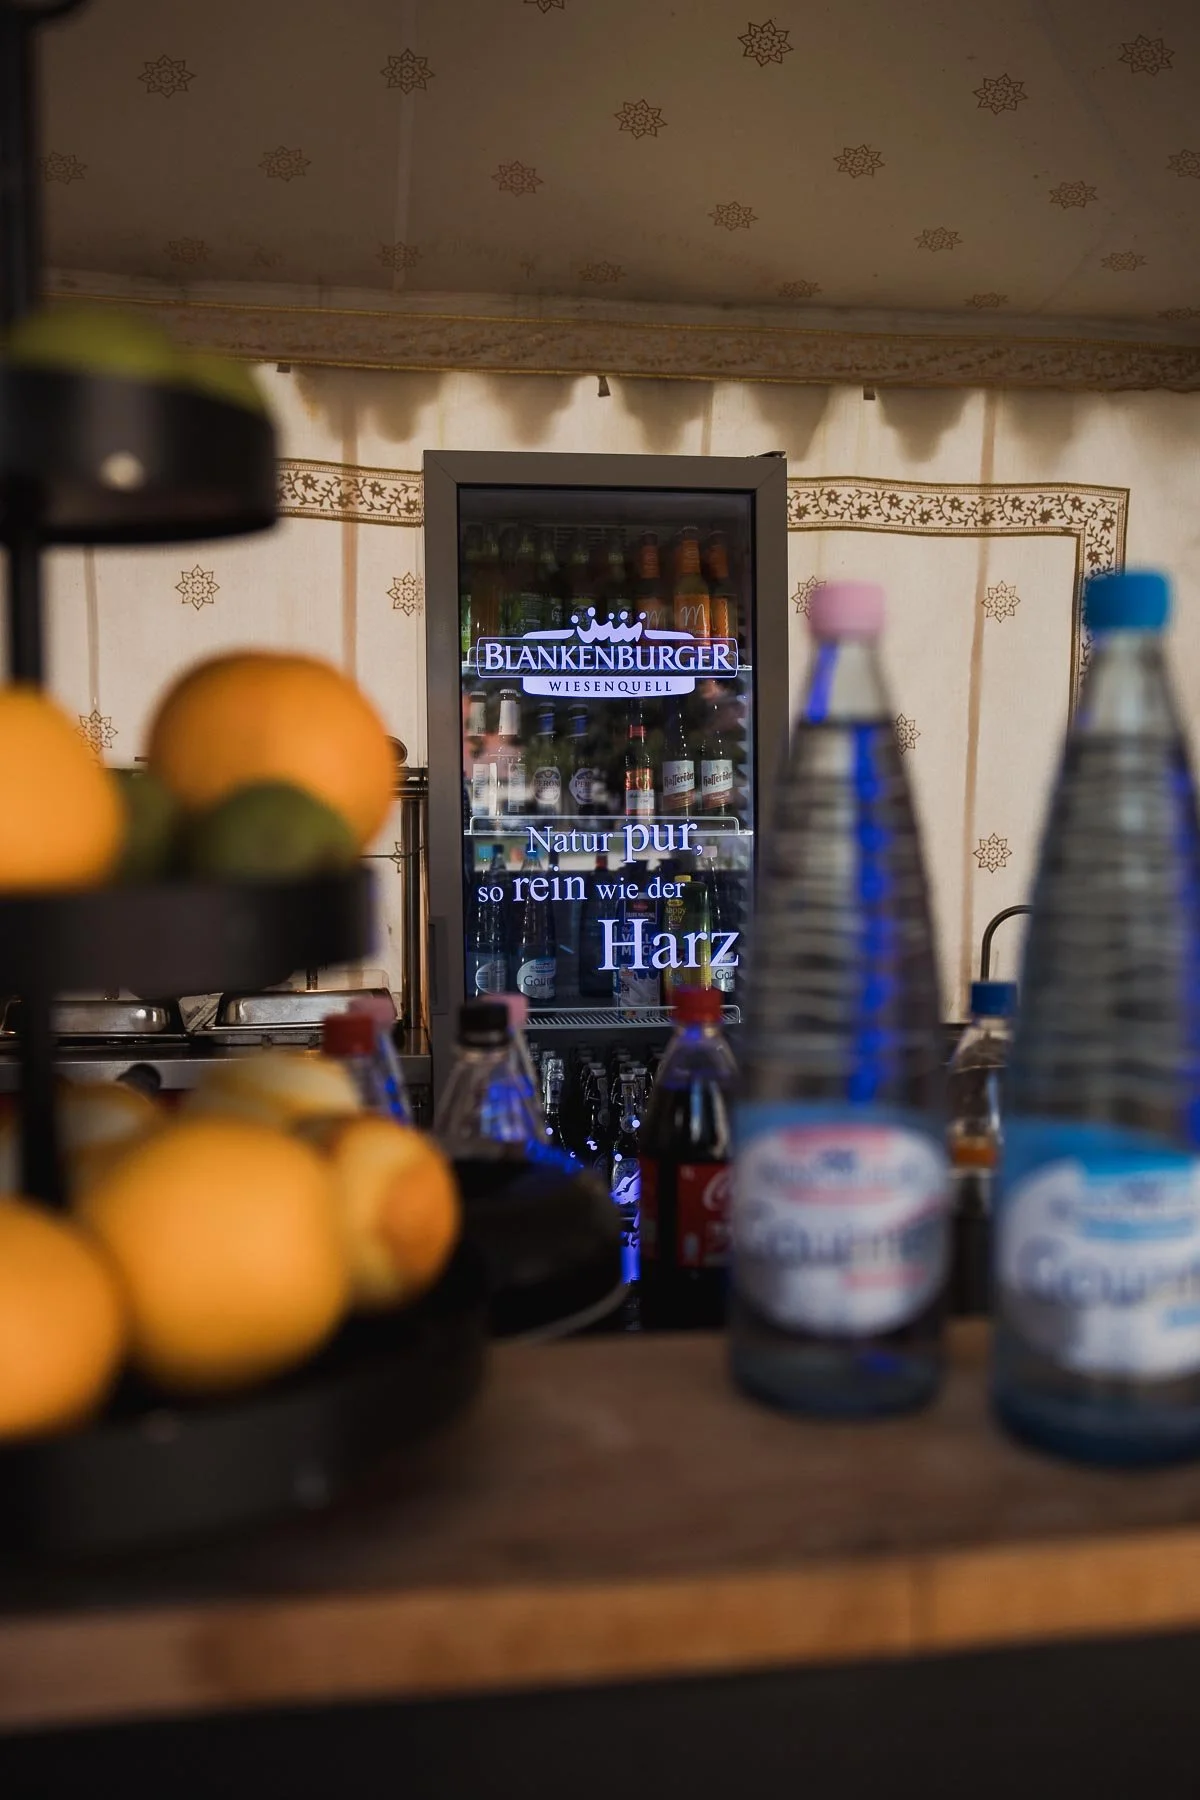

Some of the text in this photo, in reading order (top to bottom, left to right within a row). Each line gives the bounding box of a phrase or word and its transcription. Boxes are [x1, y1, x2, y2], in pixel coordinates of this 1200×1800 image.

[484, 642, 734, 671] BLANKENBURGER
[549, 680, 672, 695] WIESENQUELL
[526, 823, 703, 864] Natur pur,
[478, 865, 686, 903] so rein wie der
[597, 918, 739, 970] Harz
